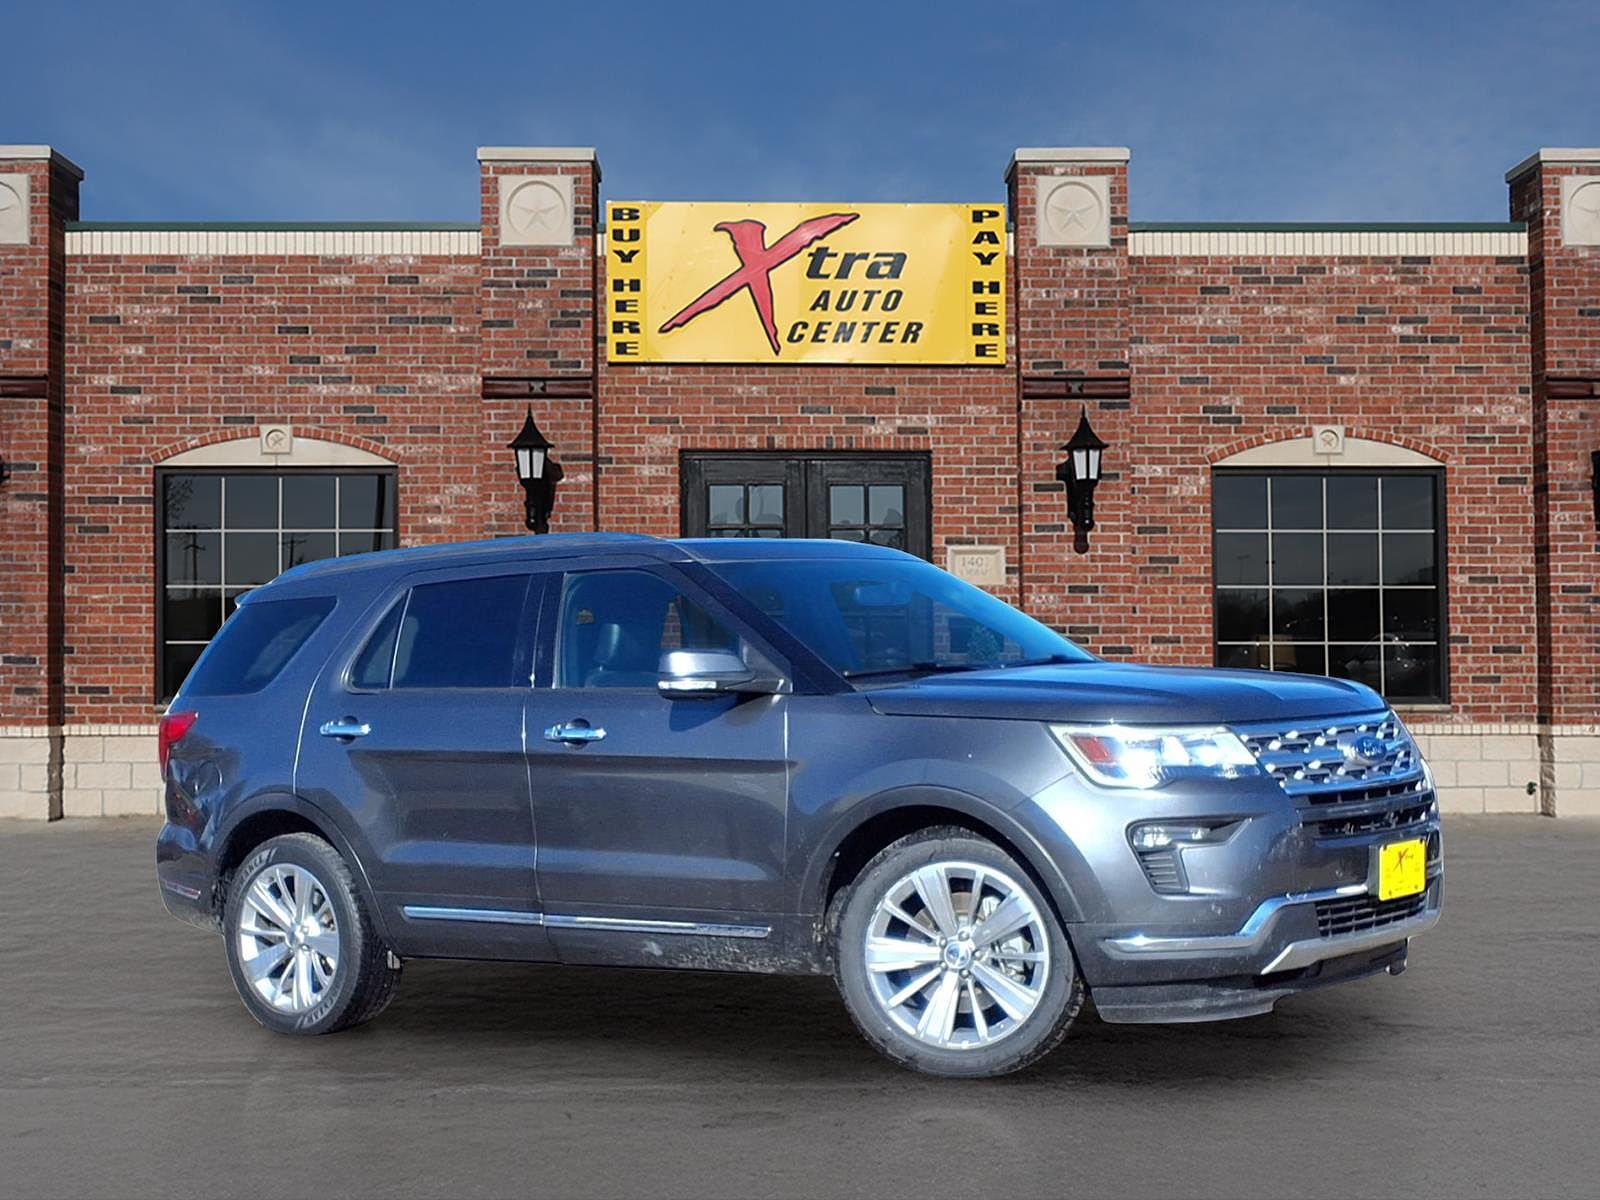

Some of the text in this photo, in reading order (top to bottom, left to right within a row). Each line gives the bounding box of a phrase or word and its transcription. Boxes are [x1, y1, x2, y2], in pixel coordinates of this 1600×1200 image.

[612, 208, 640, 355] BUY HERE
[658, 213, 907, 356] Xtra
[786, 321, 924, 344] CENTER
[810, 290, 903, 312] AUTO
[972, 210, 1000, 357] PAY HERE
